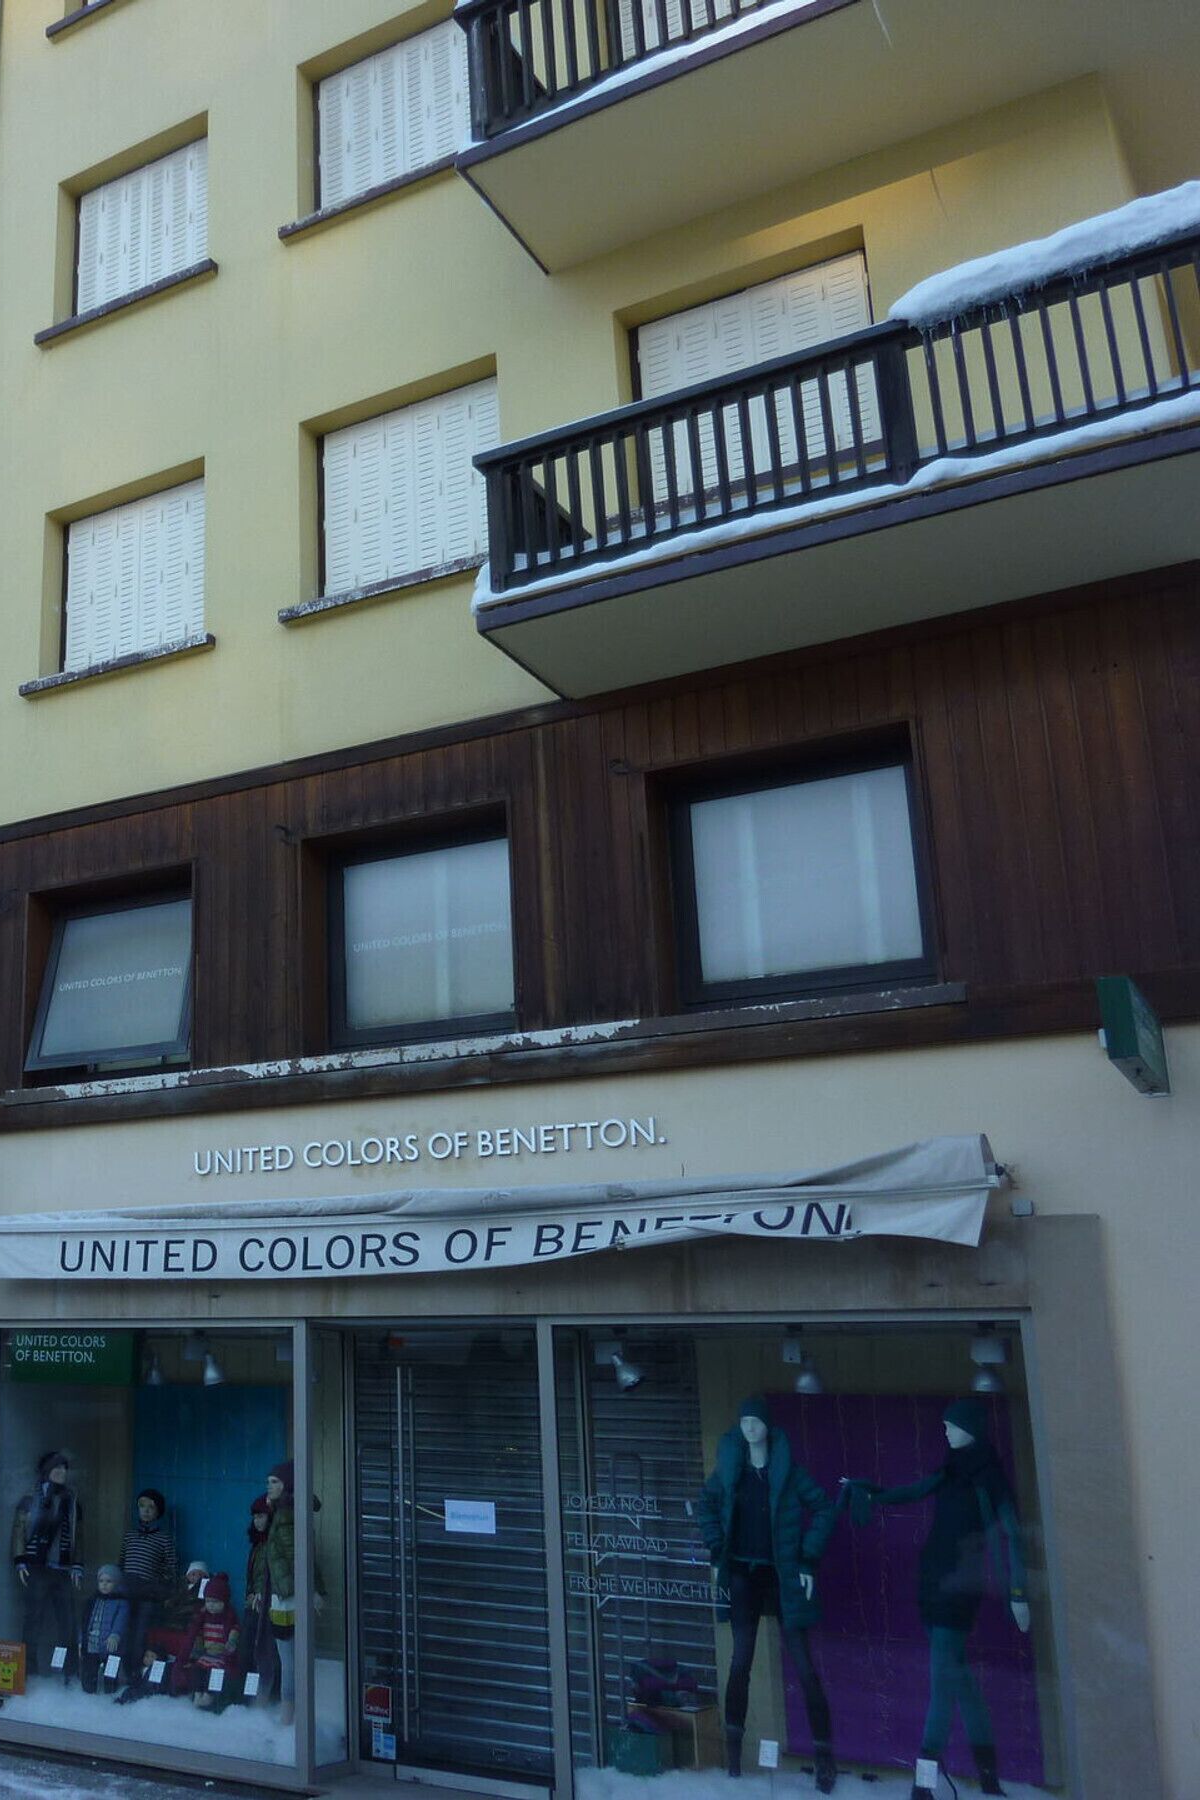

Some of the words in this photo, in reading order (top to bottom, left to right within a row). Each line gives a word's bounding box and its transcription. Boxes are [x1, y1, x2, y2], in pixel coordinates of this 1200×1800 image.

[194, 1144, 295, 1175] UNITED
[303, 1134, 419, 1168] COLORS
[428, 1131, 468, 1159] OF
[477, 1116, 667, 1157] BENETTON.
[59, 1239, 218, 1273] UNITED
[238, 1231, 421, 1271] COLORS
[444, 1227, 513, 1264] OF
[16, 1335, 58, 1347] UNITED
[60, 1335, 106, 1348] COLORS
[15, 1350, 30, 1361] OF
[564, 1496, 616, 1510] JOYEUX
[565, 1533, 600, 1547] FELIZ
[604, 1536, 668, 1552] NAVIDAD
[569, 1576, 619, 1593] FROHE
[622, 1579, 731, 1601] WEIHNACHTEN
